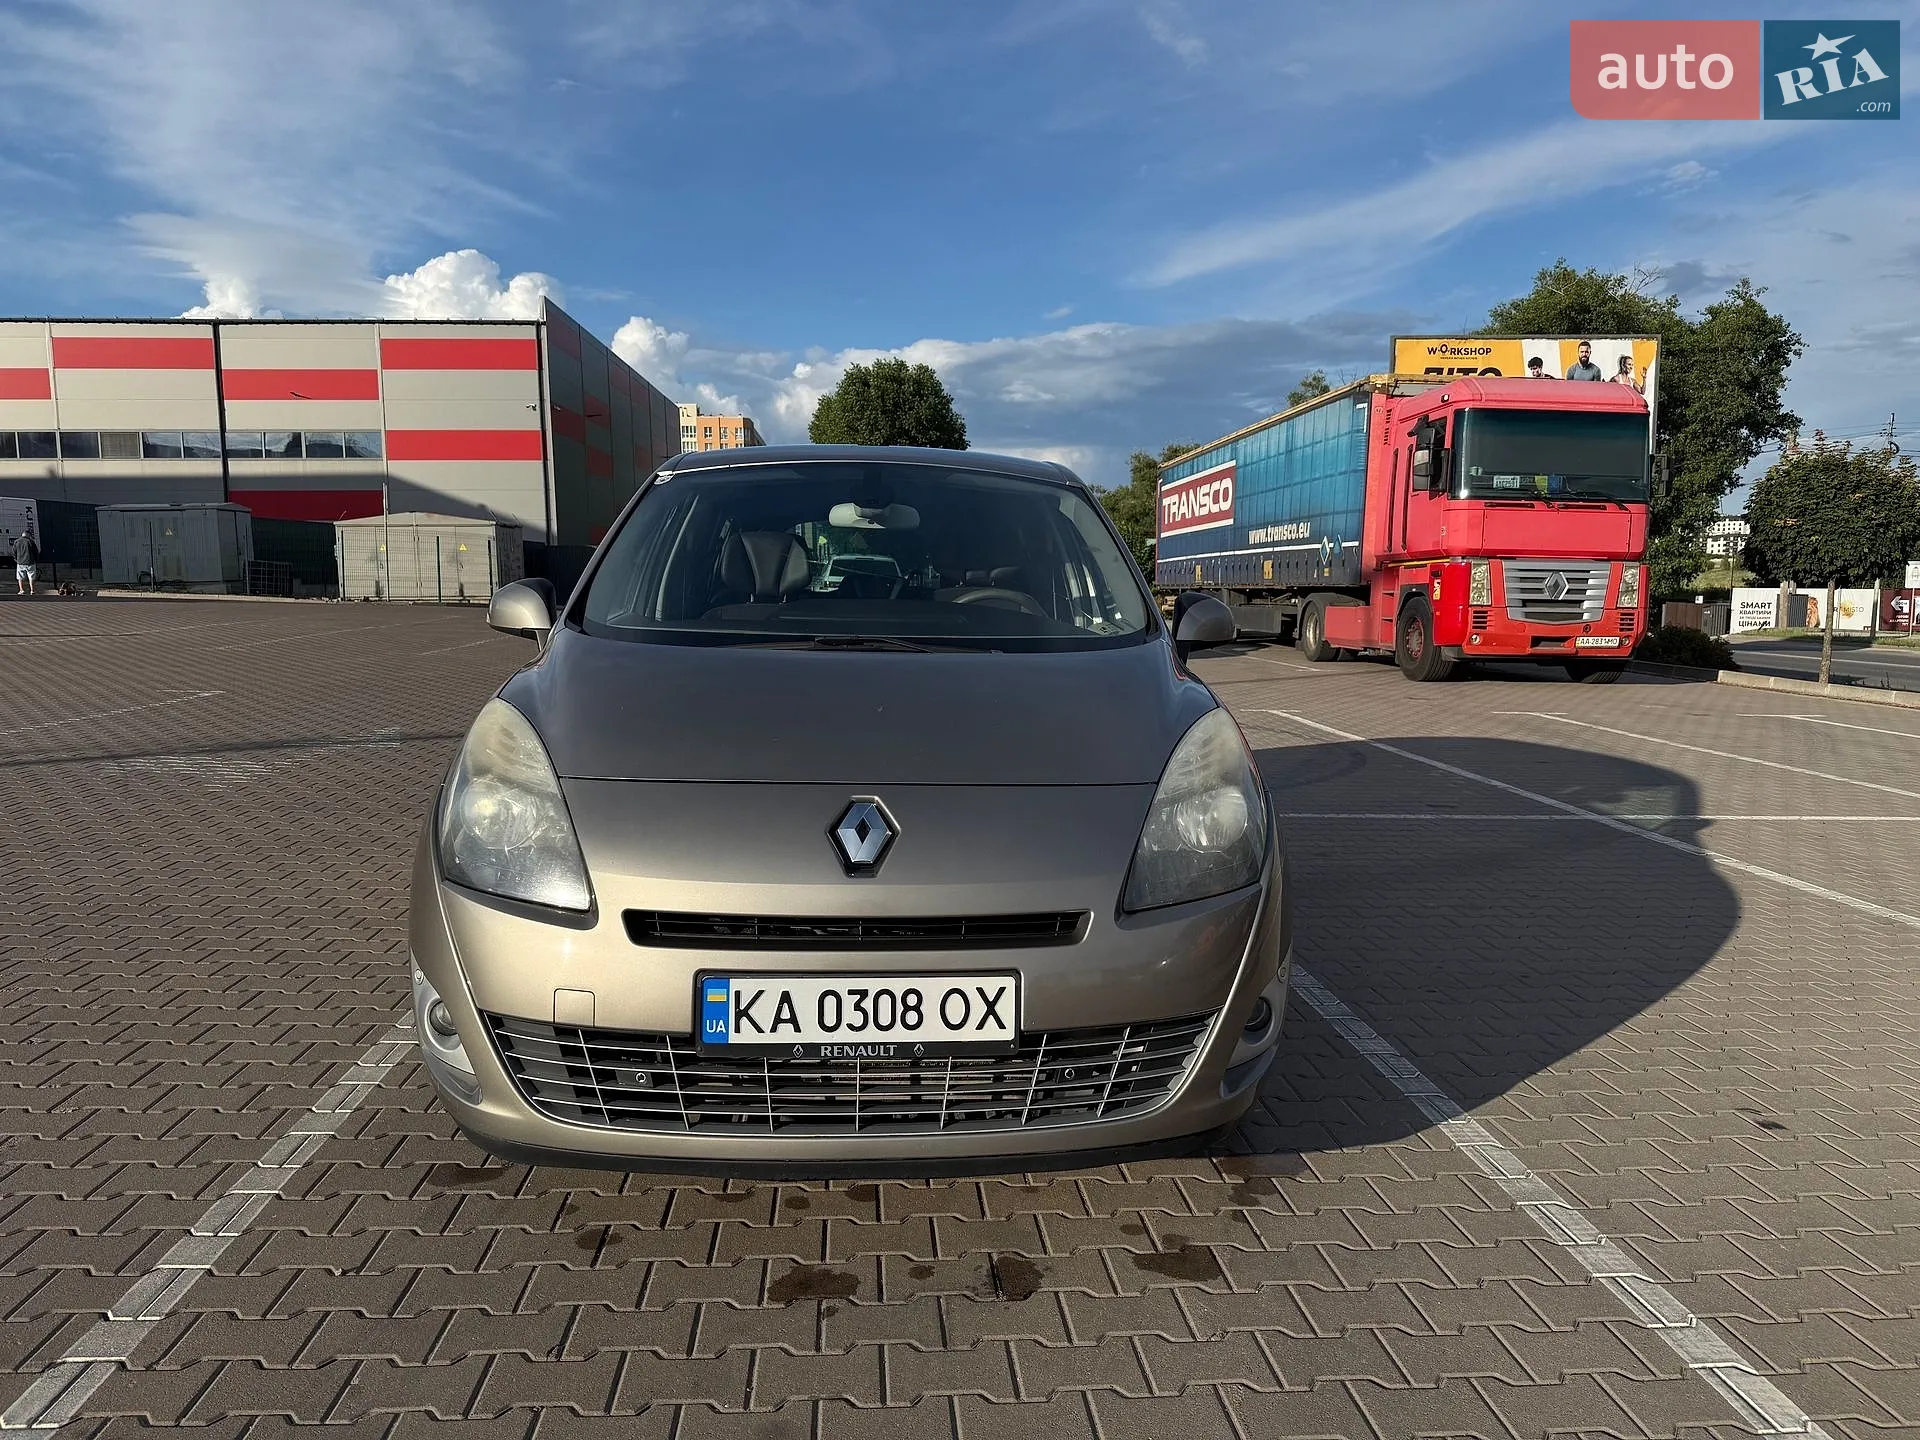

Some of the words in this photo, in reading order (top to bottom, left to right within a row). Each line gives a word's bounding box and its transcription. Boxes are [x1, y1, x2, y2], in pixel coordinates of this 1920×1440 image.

[1427, 343, 1492, 356] WORKSHOP
[1162, 477, 1233, 525] TRANSCO
[1248, 520, 1311, 545] www.transco.eu
[1740, 601, 1772, 609] SMART
[733, 989, 802, 1034] KA
[817, 987, 924, 1033] 0308
[939, 986, 1007, 1031] OX
[706, 1019, 726, 1034] UA
[820, 1044, 898, 1058] RENAULT
